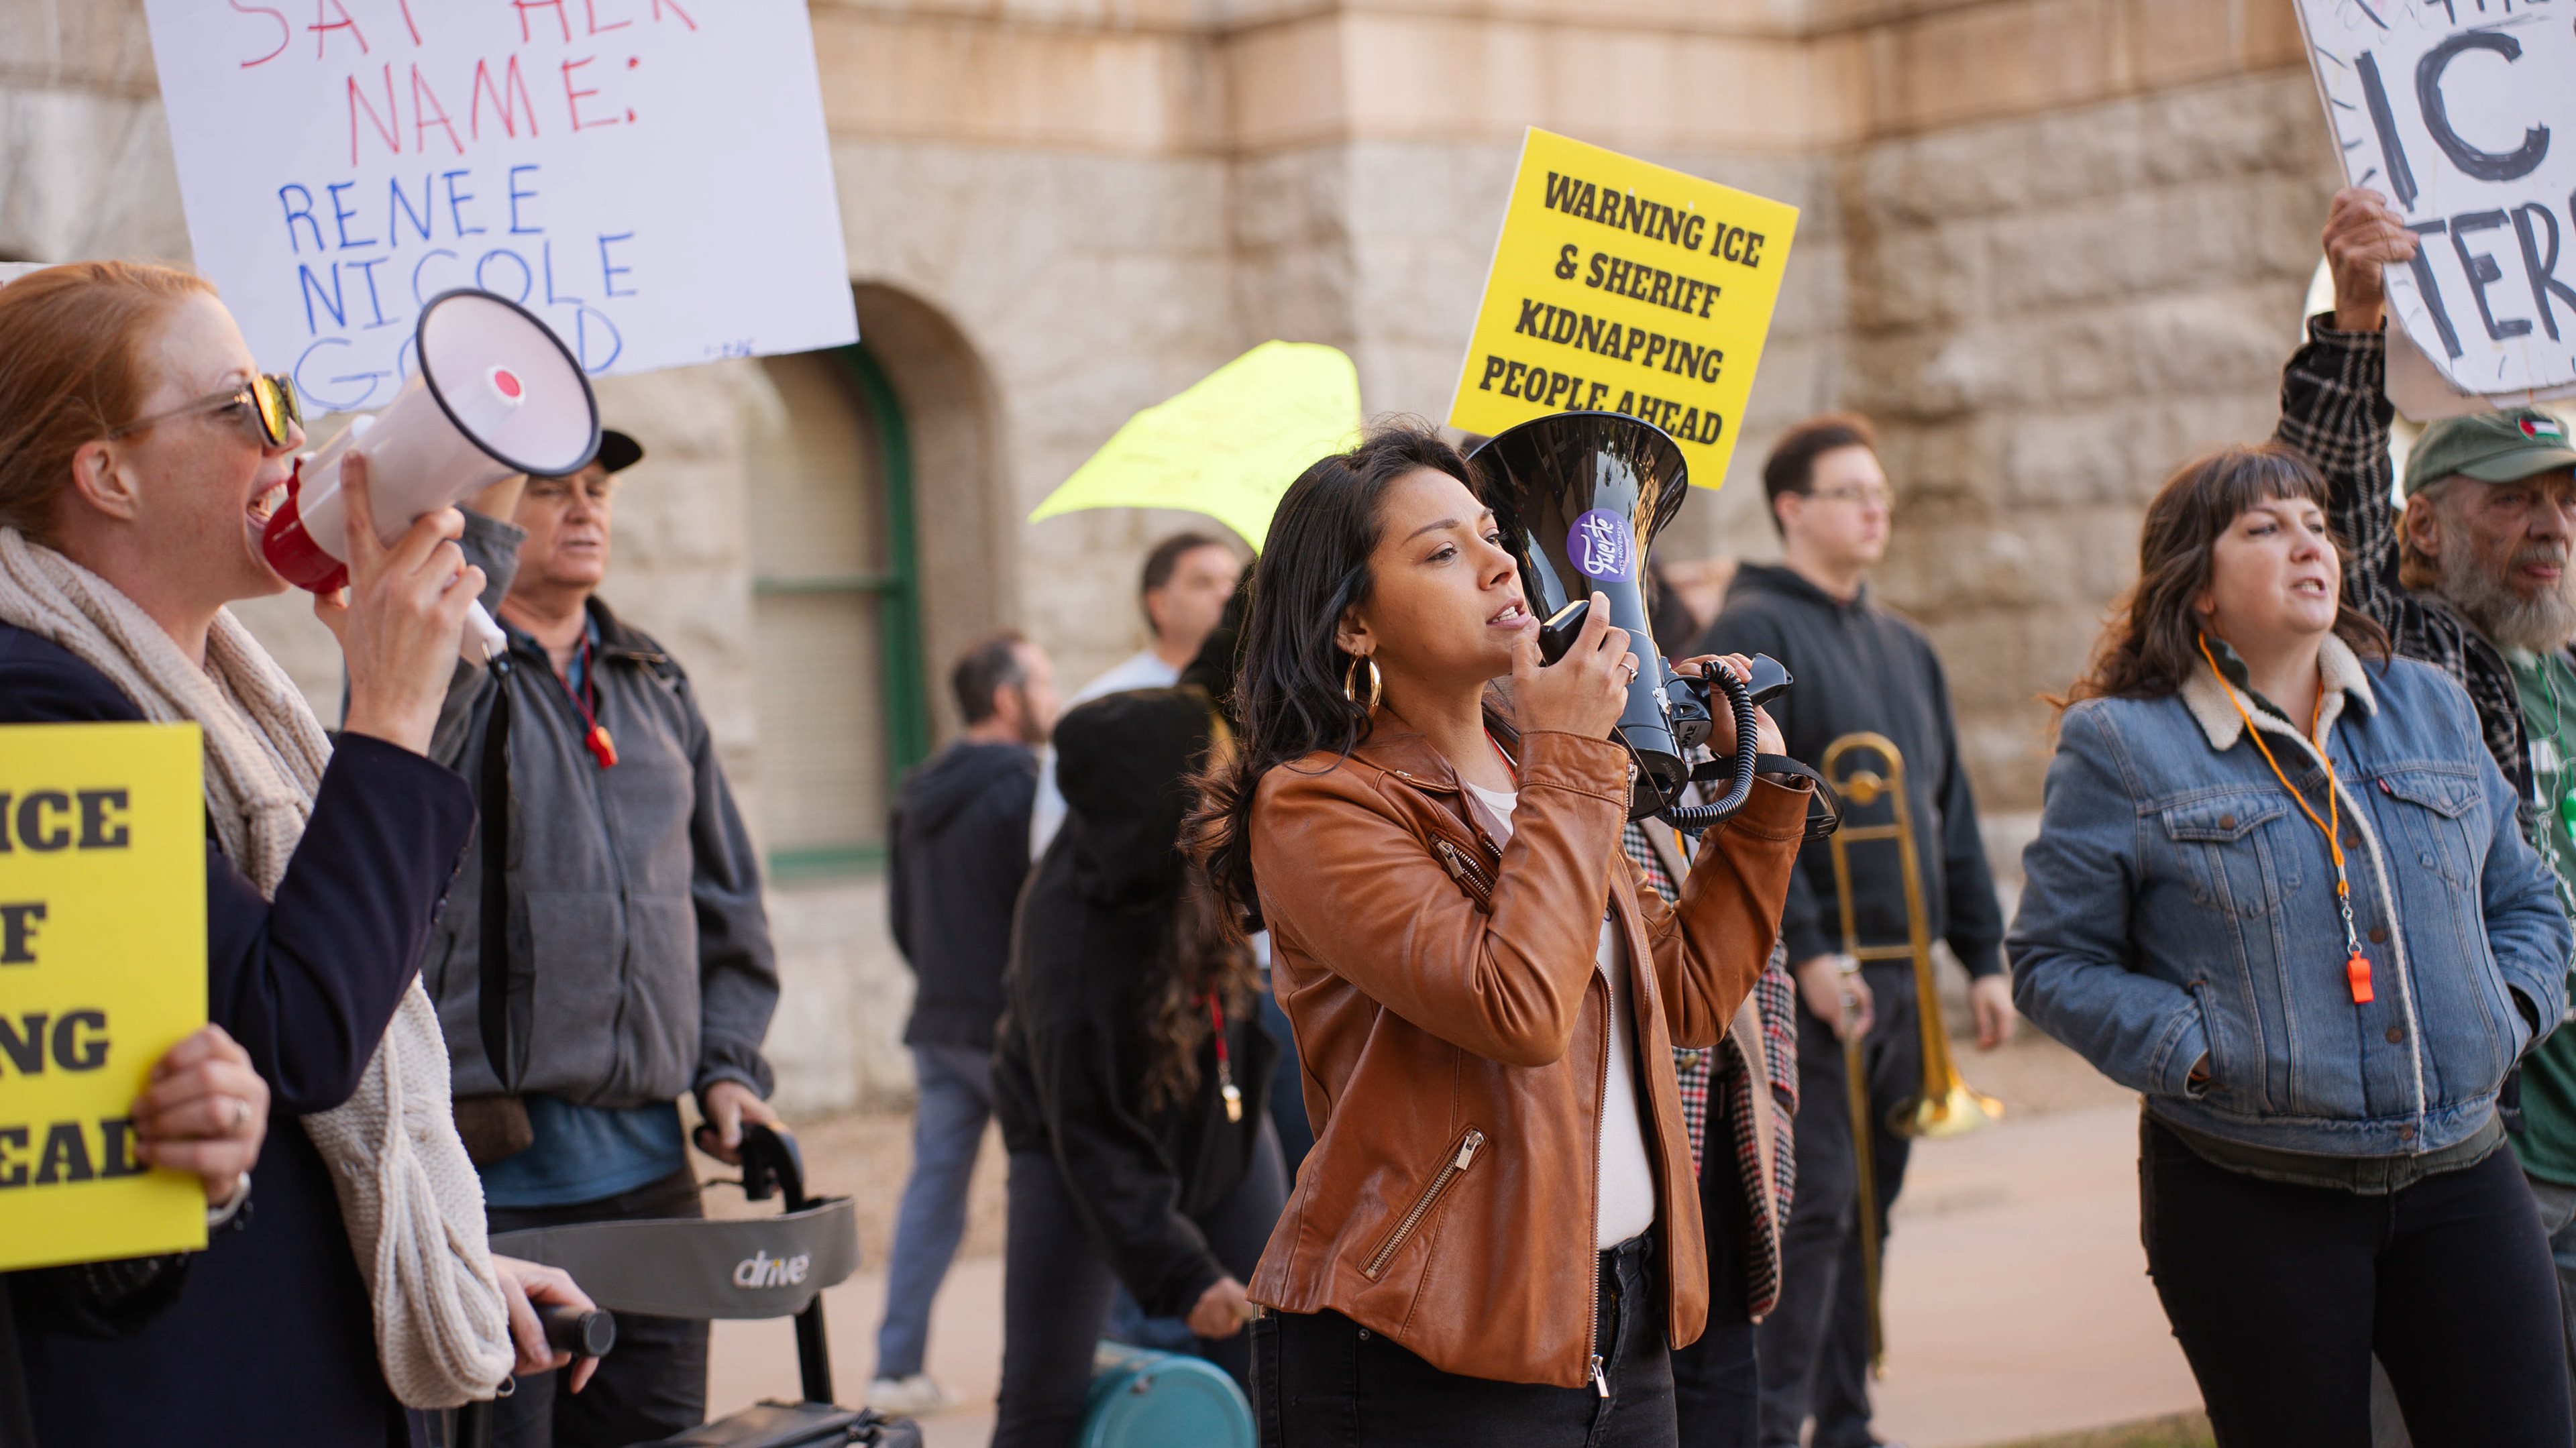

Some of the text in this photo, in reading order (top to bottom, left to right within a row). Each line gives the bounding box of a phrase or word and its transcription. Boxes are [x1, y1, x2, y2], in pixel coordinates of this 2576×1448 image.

[348, 54, 641, 168] NAME:
[2355, 17, 2576, 213] IC
[278, 165, 547, 254] RENEE
[1544, 171, 1766, 268] WARNING ICE
[299, 232, 639, 335] NICOLE
[1554, 243, 1721, 319] & SHERIFF
[2404, 188, 2576, 358] TER
[293, 306, 622, 411] GD
[1479, 355, 1609, 412] PEOPLE
[1514, 298, 1724, 384] KIDNAPPING
[1616, 390, 1723, 446] AHEAD
[1617, 519, 1625, 558] MOVEMENT
[733, 1249, 810, 1289] drive
